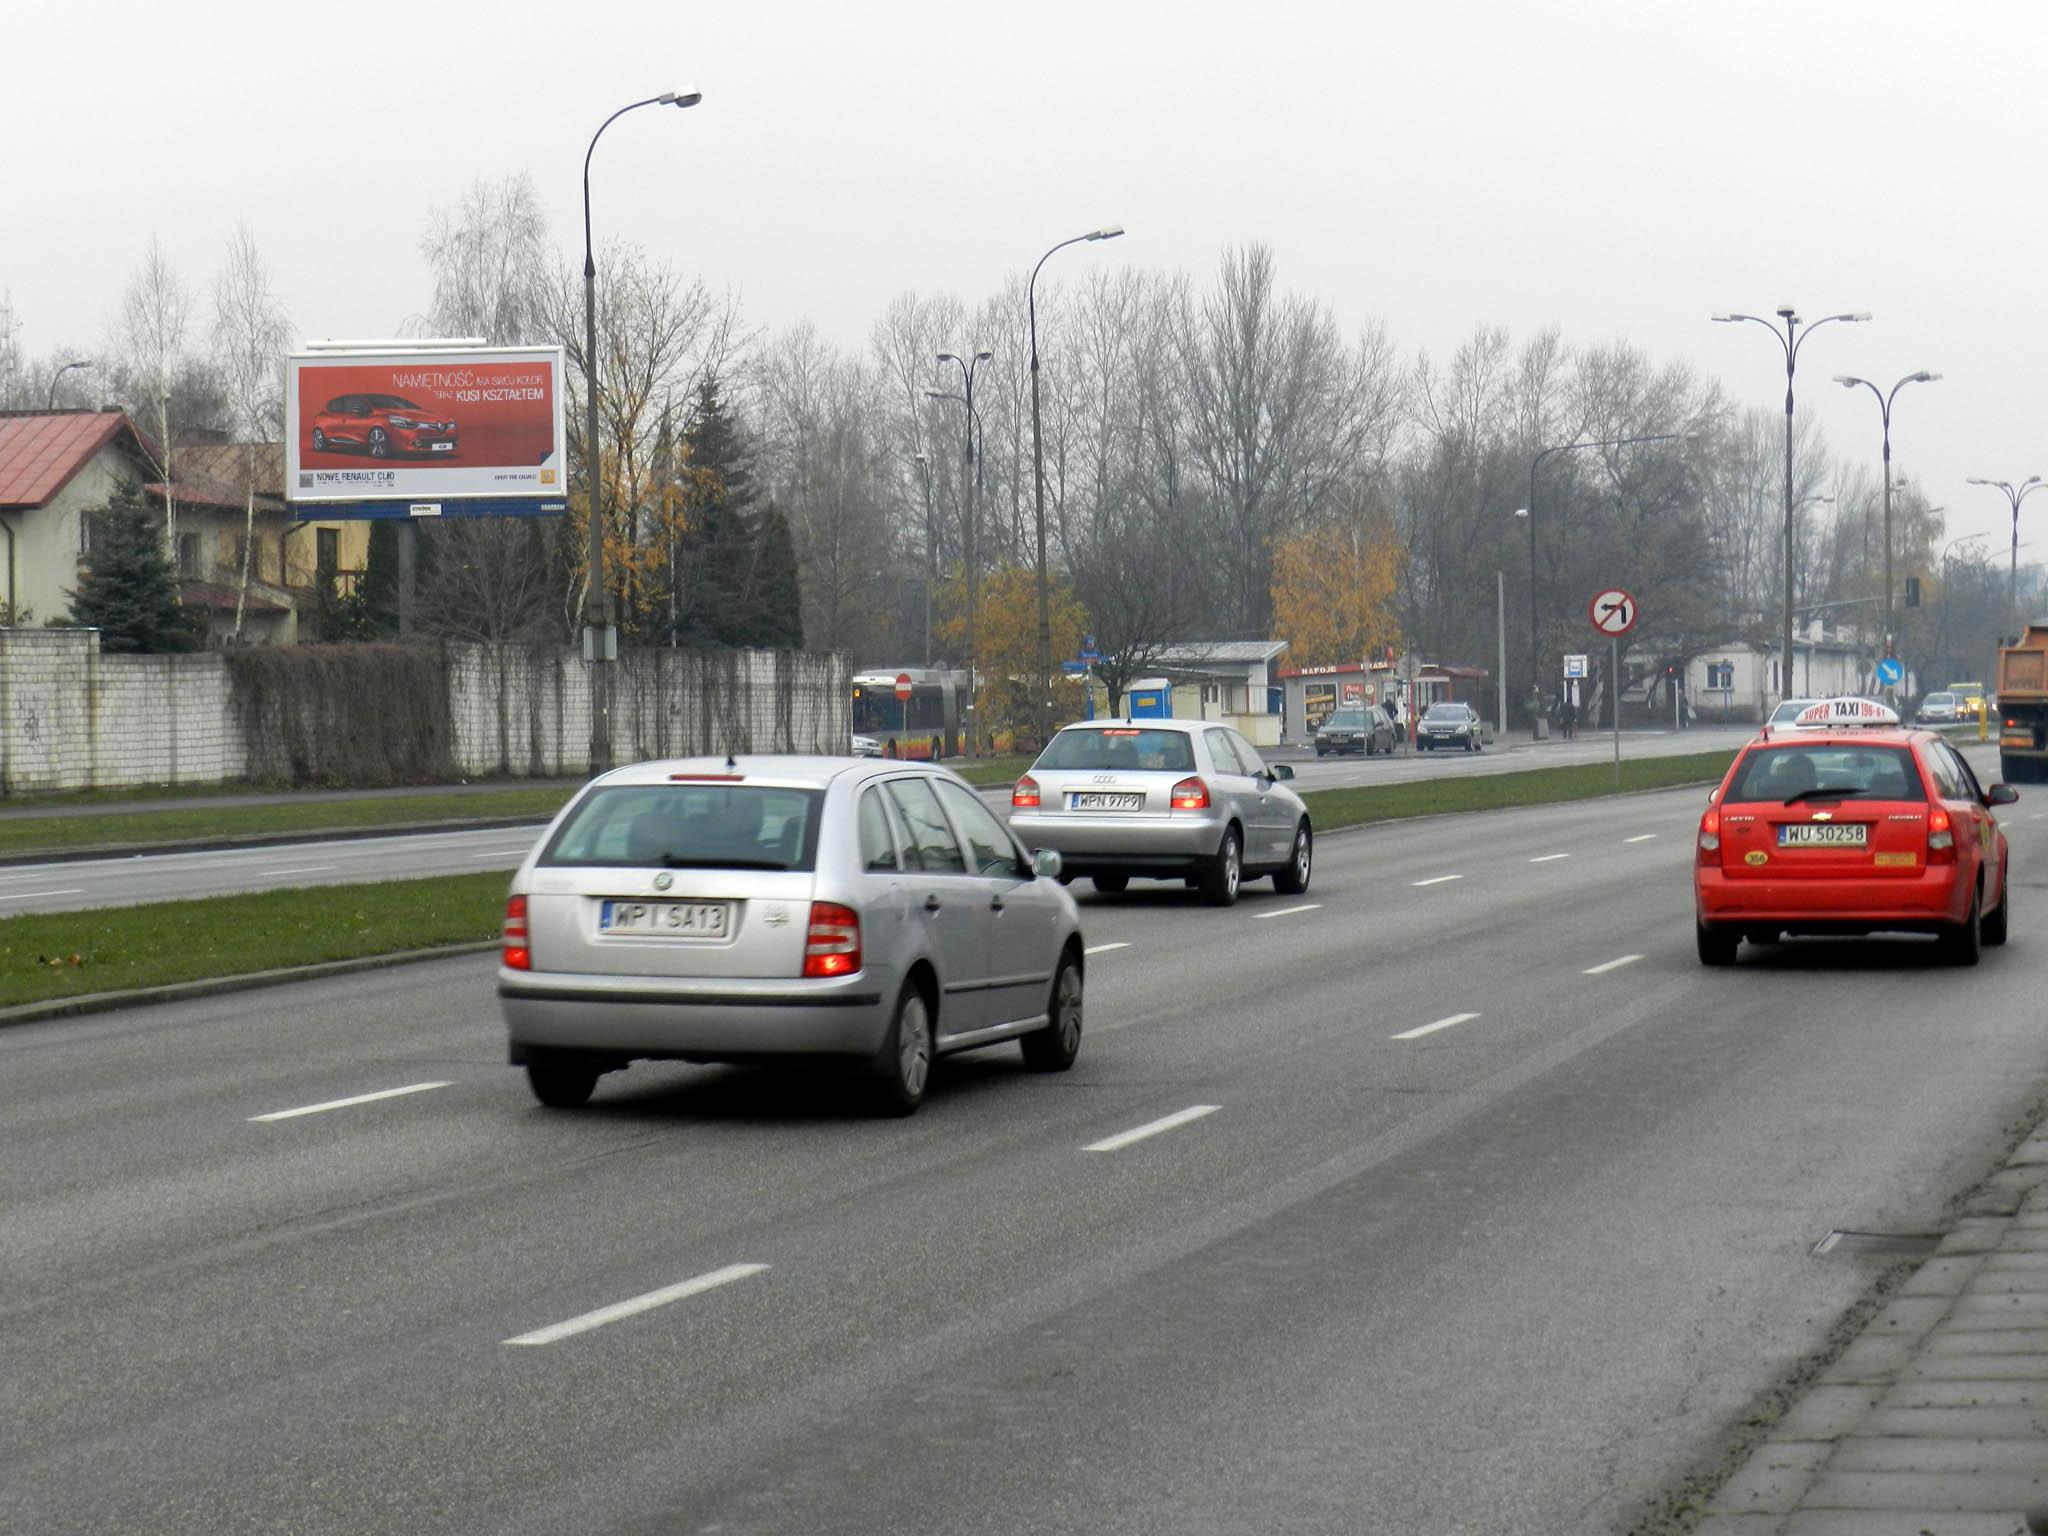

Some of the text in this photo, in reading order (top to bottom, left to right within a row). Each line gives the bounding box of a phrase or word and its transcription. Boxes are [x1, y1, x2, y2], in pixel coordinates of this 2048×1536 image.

[392, 369, 473, 391] NAMIĘTNOŚĆ
[456, 389, 480, 402] KUSI
[483, 387, 544, 401] KSZTAŁTEM
[316, 471, 395, 481] NOWE RENAULT CLIO
[1301, 665, 1337, 675] NAPOJE
[1804, 703, 1831, 720] SUPER
[1834, 702, 1859, 717] TAXI
[1080, 794, 1106, 808] WPN
[1788, 826, 1865, 843] WU 50258
[667, 904, 723, 930] SA13
